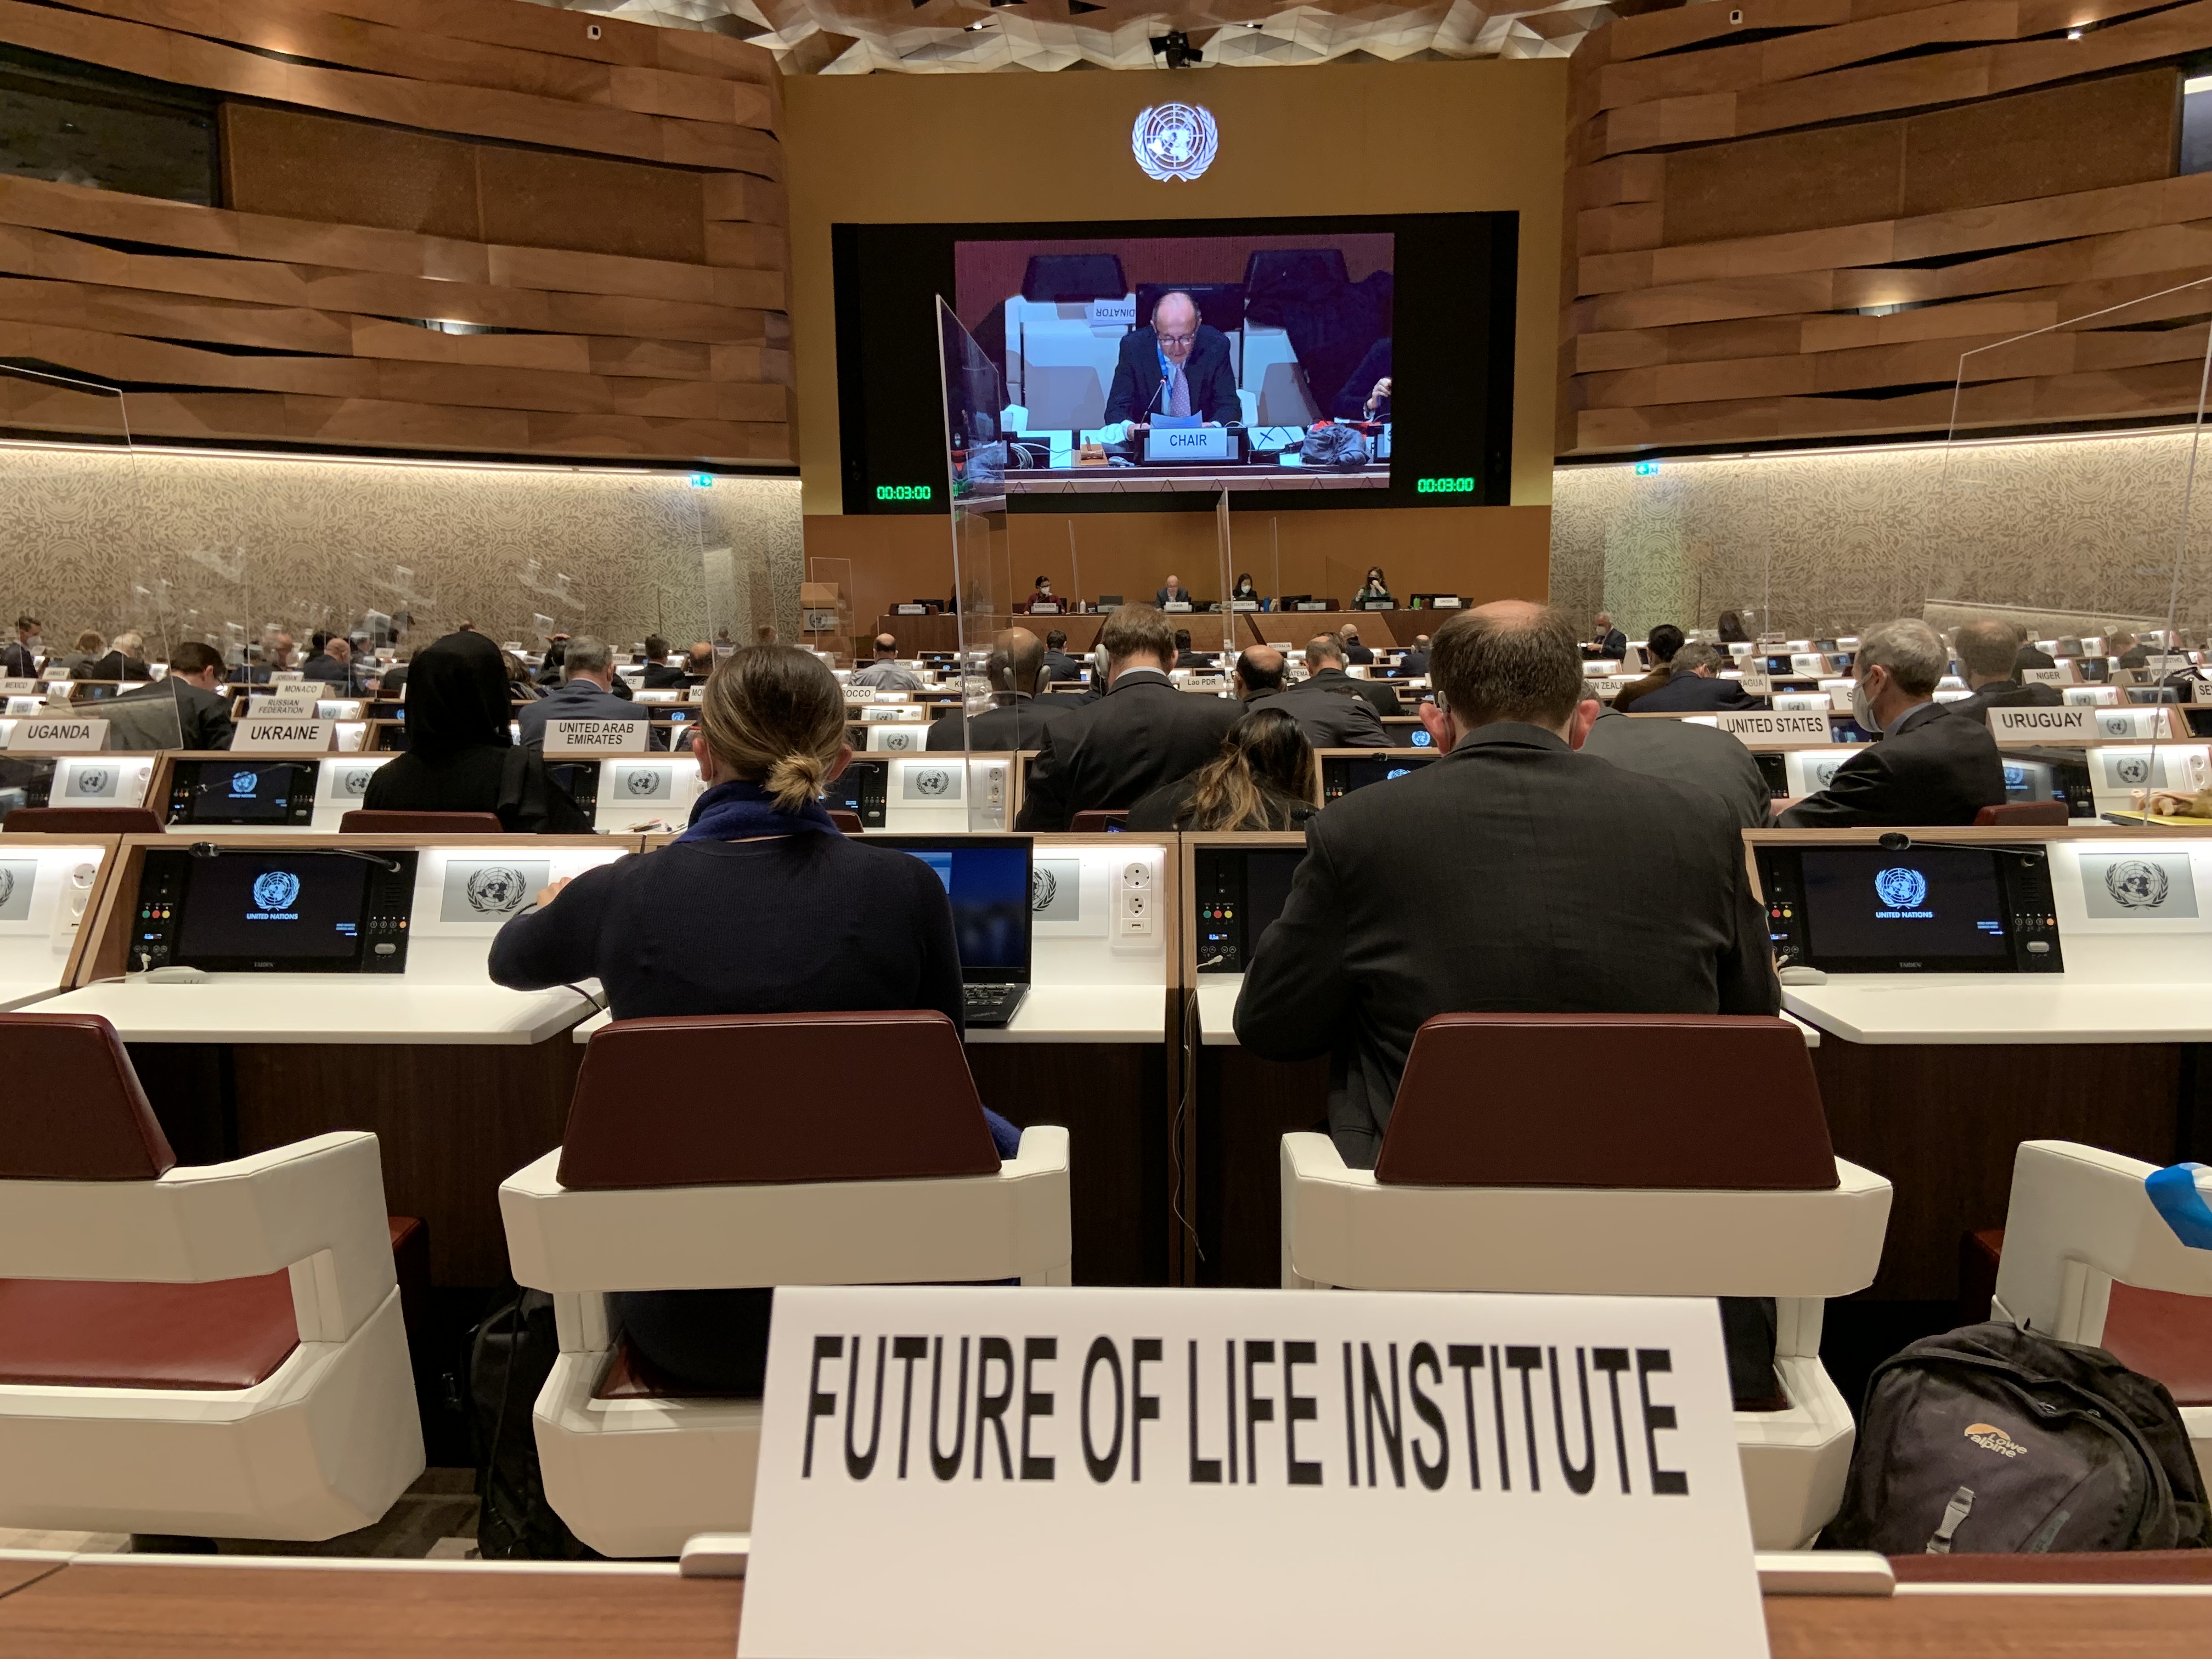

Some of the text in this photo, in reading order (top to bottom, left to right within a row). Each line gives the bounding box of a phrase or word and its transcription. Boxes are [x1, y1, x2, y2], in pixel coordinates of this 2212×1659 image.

[1096, 308, 1135, 317] DINATOR
[1170, 435, 1207, 446] CHAIR
[1418, 477, 1475, 493] 00:03:00
[877, 486, 931, 500] 00:03:00
[1727, 718, 1824, 732] UNITED STATES
[2001, 713, 2083, 728] URUGUAY
[28, 725, 89, 738] UGANDA
[251, 726, 320, 740] UKRAINE
[559, 723, 634, 733] UNITED ARAB
[567, 734, 623, 744] EMIRATES
[801, 1334, 1690, 1496] FUTURE OF LIFE INSTITUTE
[1970, 1435, 2016, 1458] alpine
[1987, 1434, 2028, 1454] Lowe
